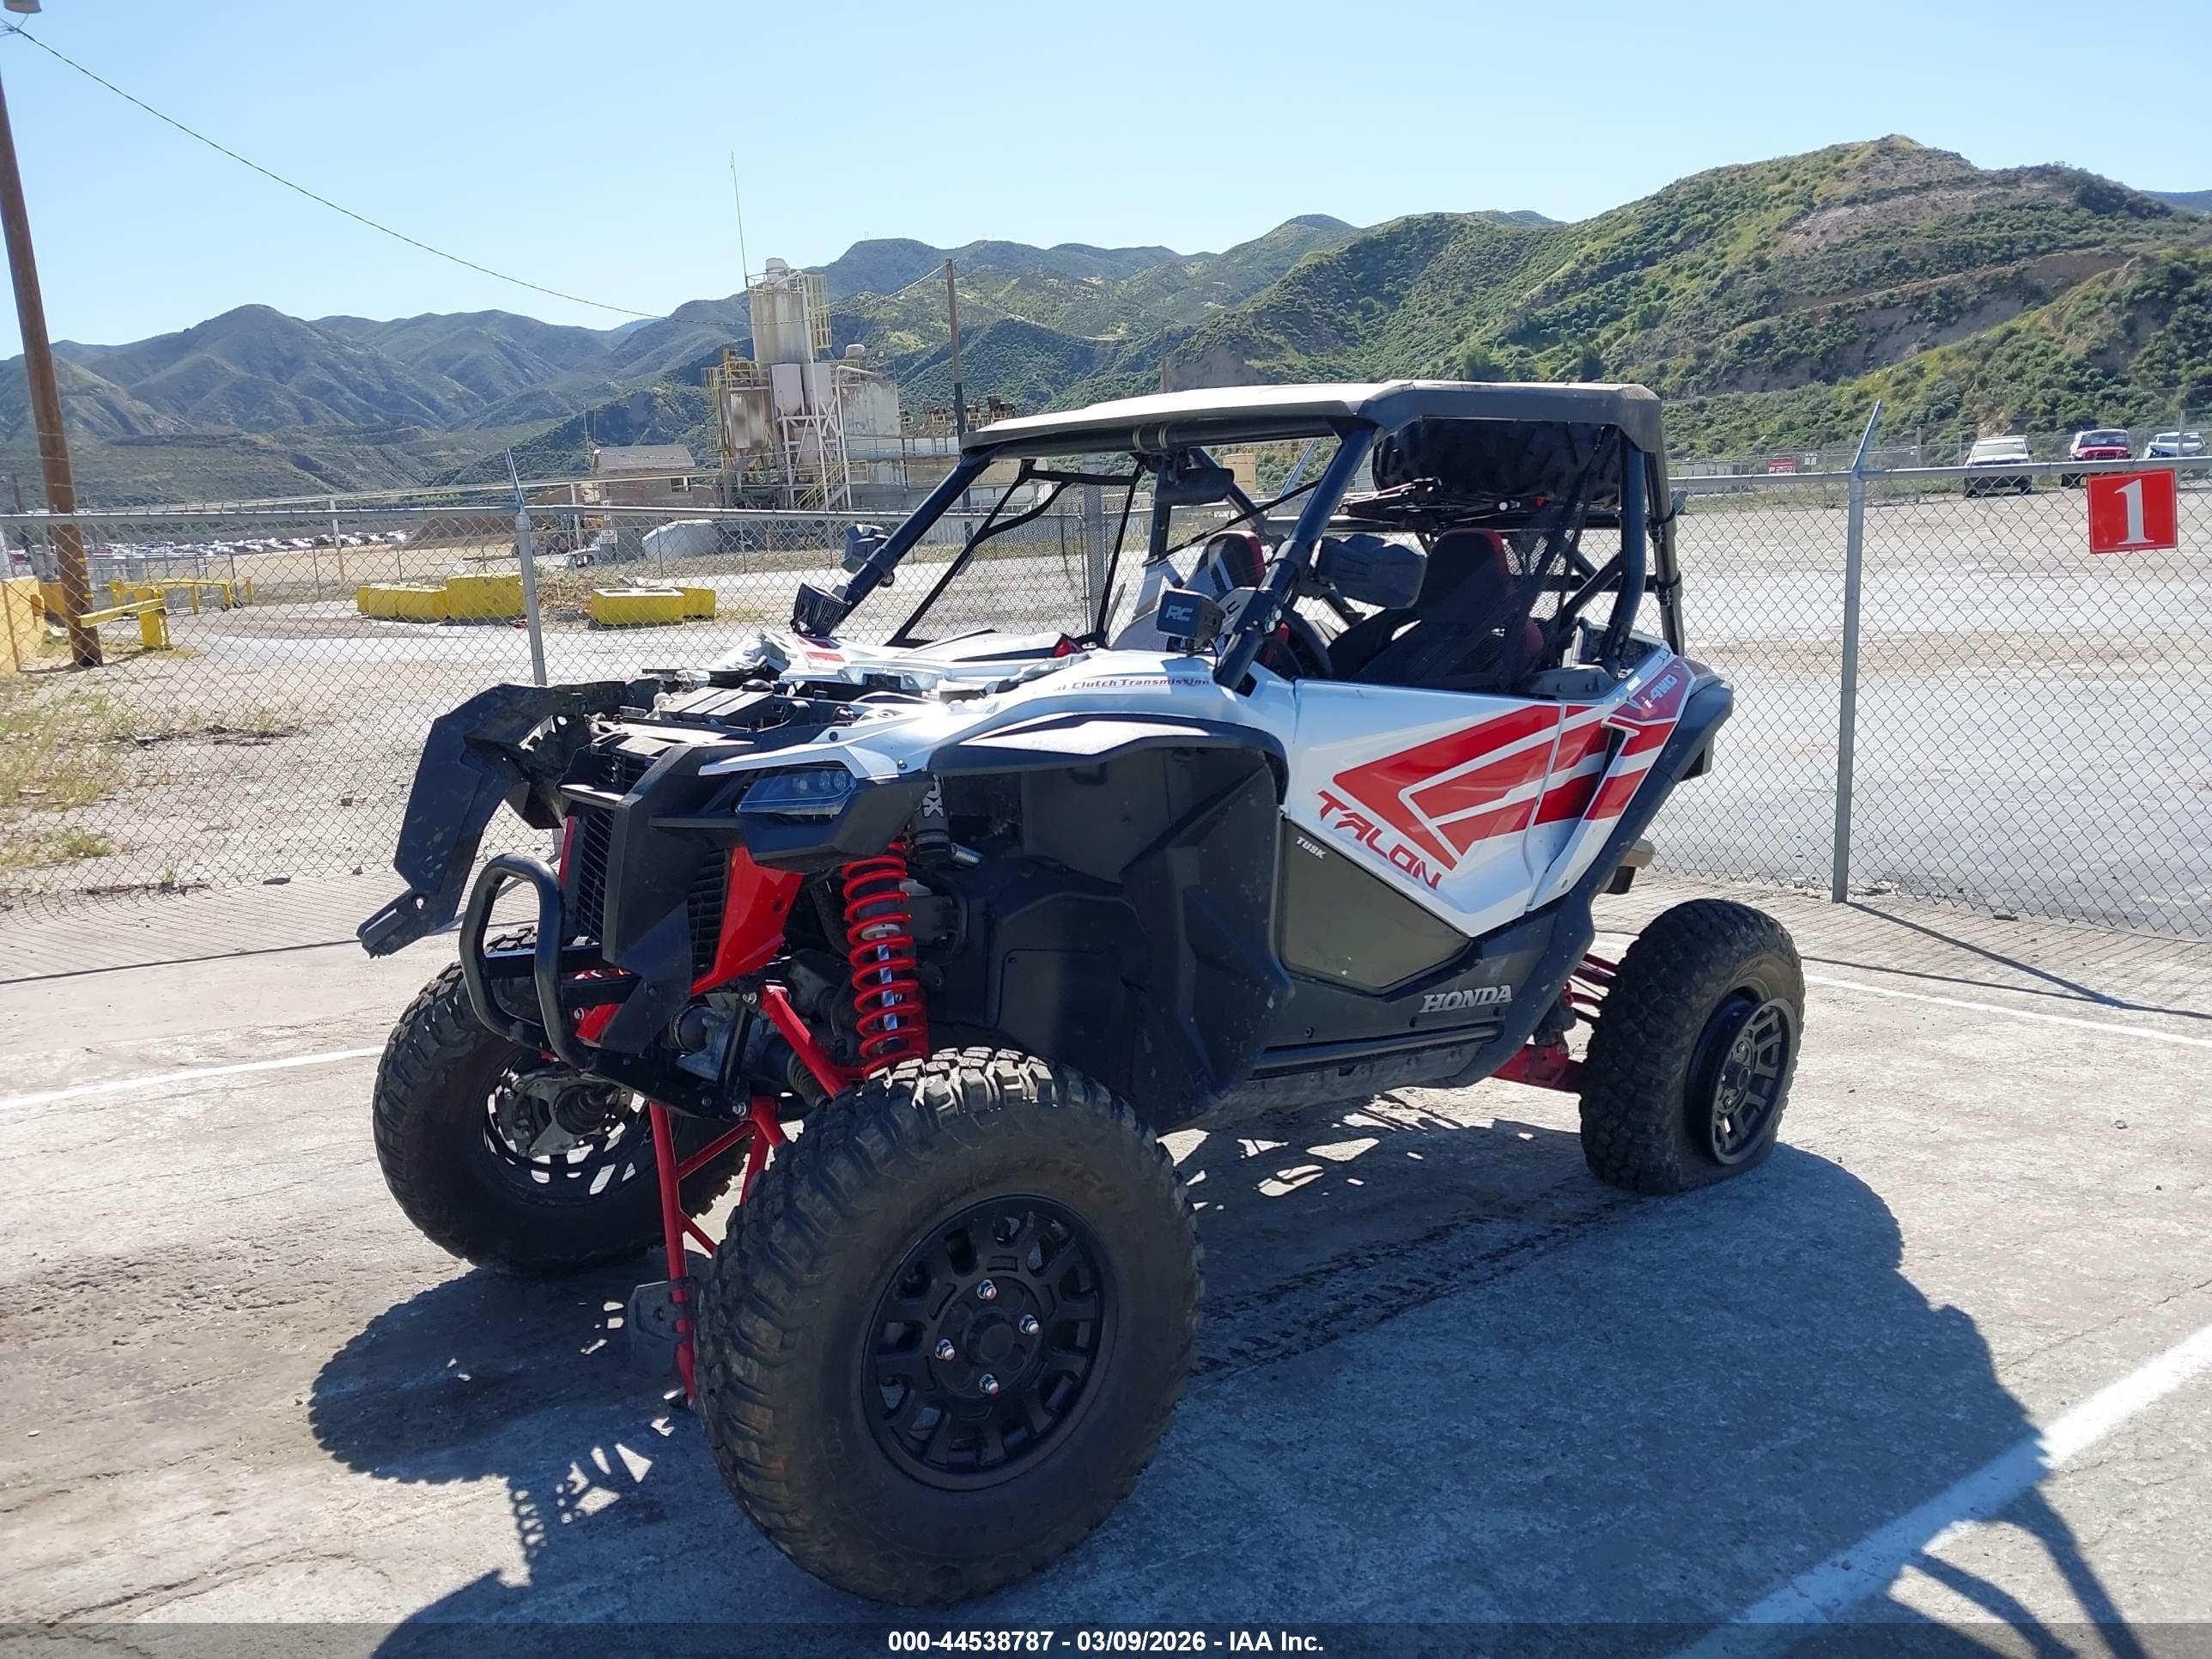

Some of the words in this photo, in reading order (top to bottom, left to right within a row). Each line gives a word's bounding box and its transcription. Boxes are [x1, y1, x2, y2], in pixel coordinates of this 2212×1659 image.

[2114, 478, 2155, 546] 1
[1165, 605, 1194, 622] RC
[1073, 678, 1118, 690] Clutch
[1119, 678, 1211, 688] Transmission
[1297, 836, 1327, 860] TUSK
[1317, 790, 1443, 890] TALON
[1418, 984, 1513, 1013] HONDA
